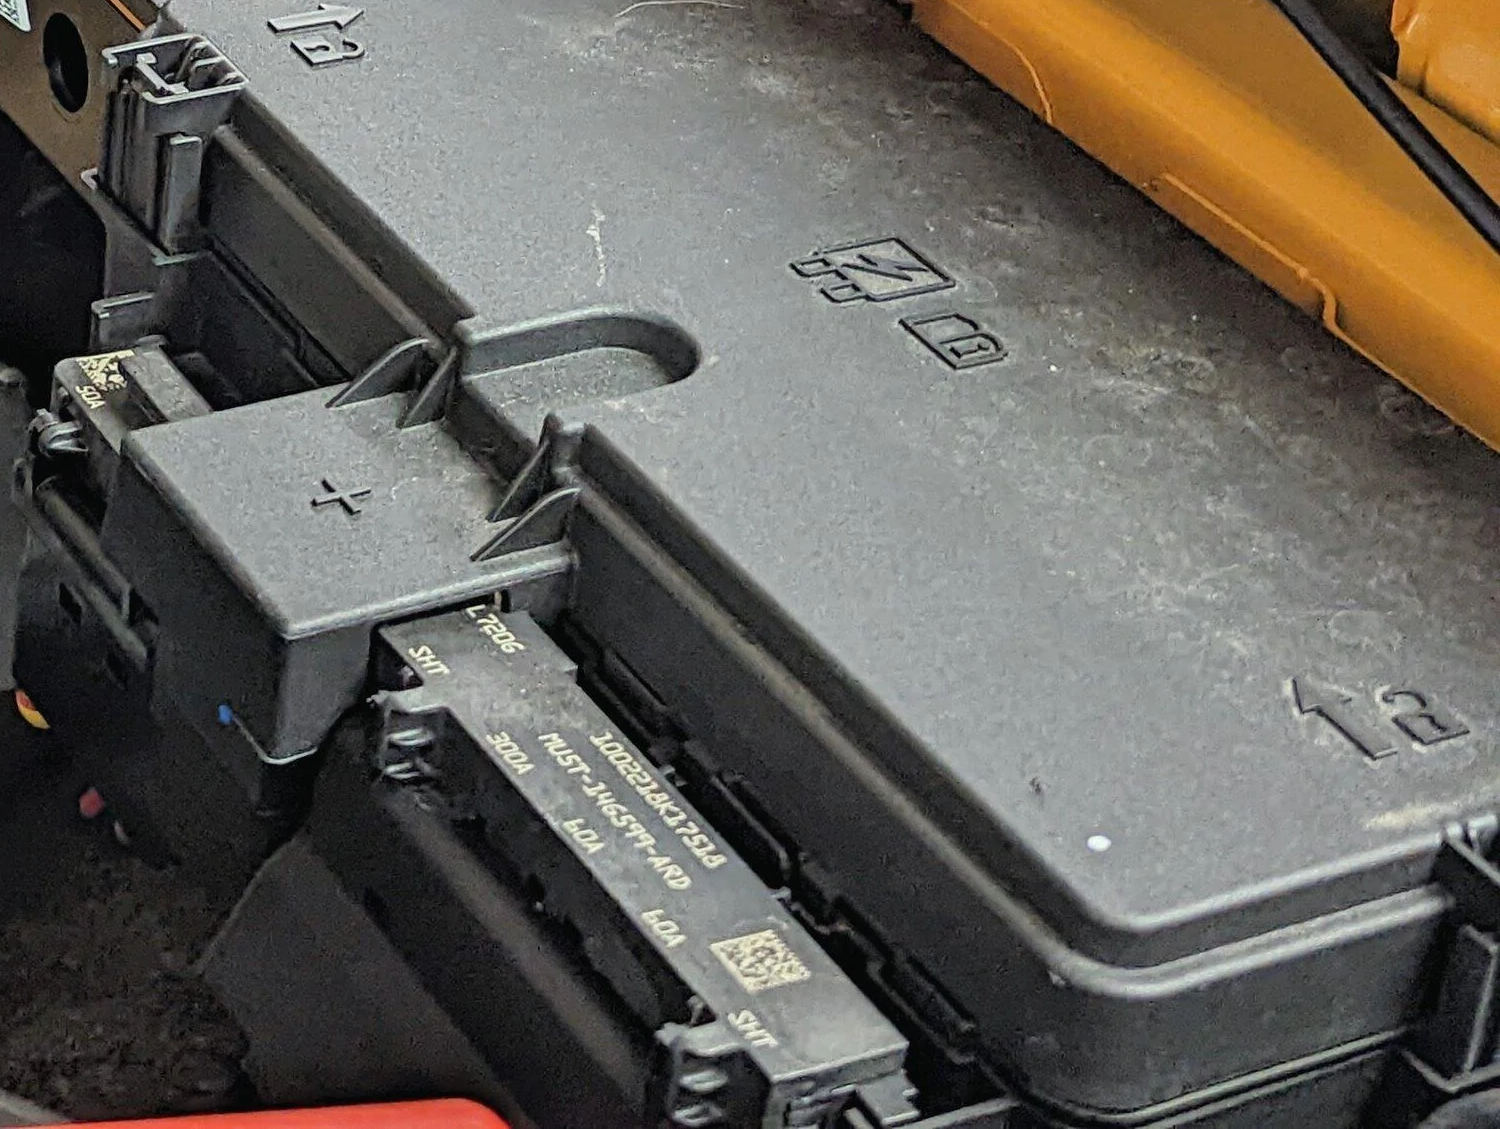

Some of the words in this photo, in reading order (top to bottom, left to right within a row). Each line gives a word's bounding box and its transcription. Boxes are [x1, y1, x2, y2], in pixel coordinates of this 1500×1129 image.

[75, 385, 106, 409] 50A
[408, 644, 450, 676] SHT
[486, 731, 535, 775] 300A
[562, 818, 605, 854] 60A
[641, 908, 688, 949] 60A
[728, 1009, 779, 1049] SHT
